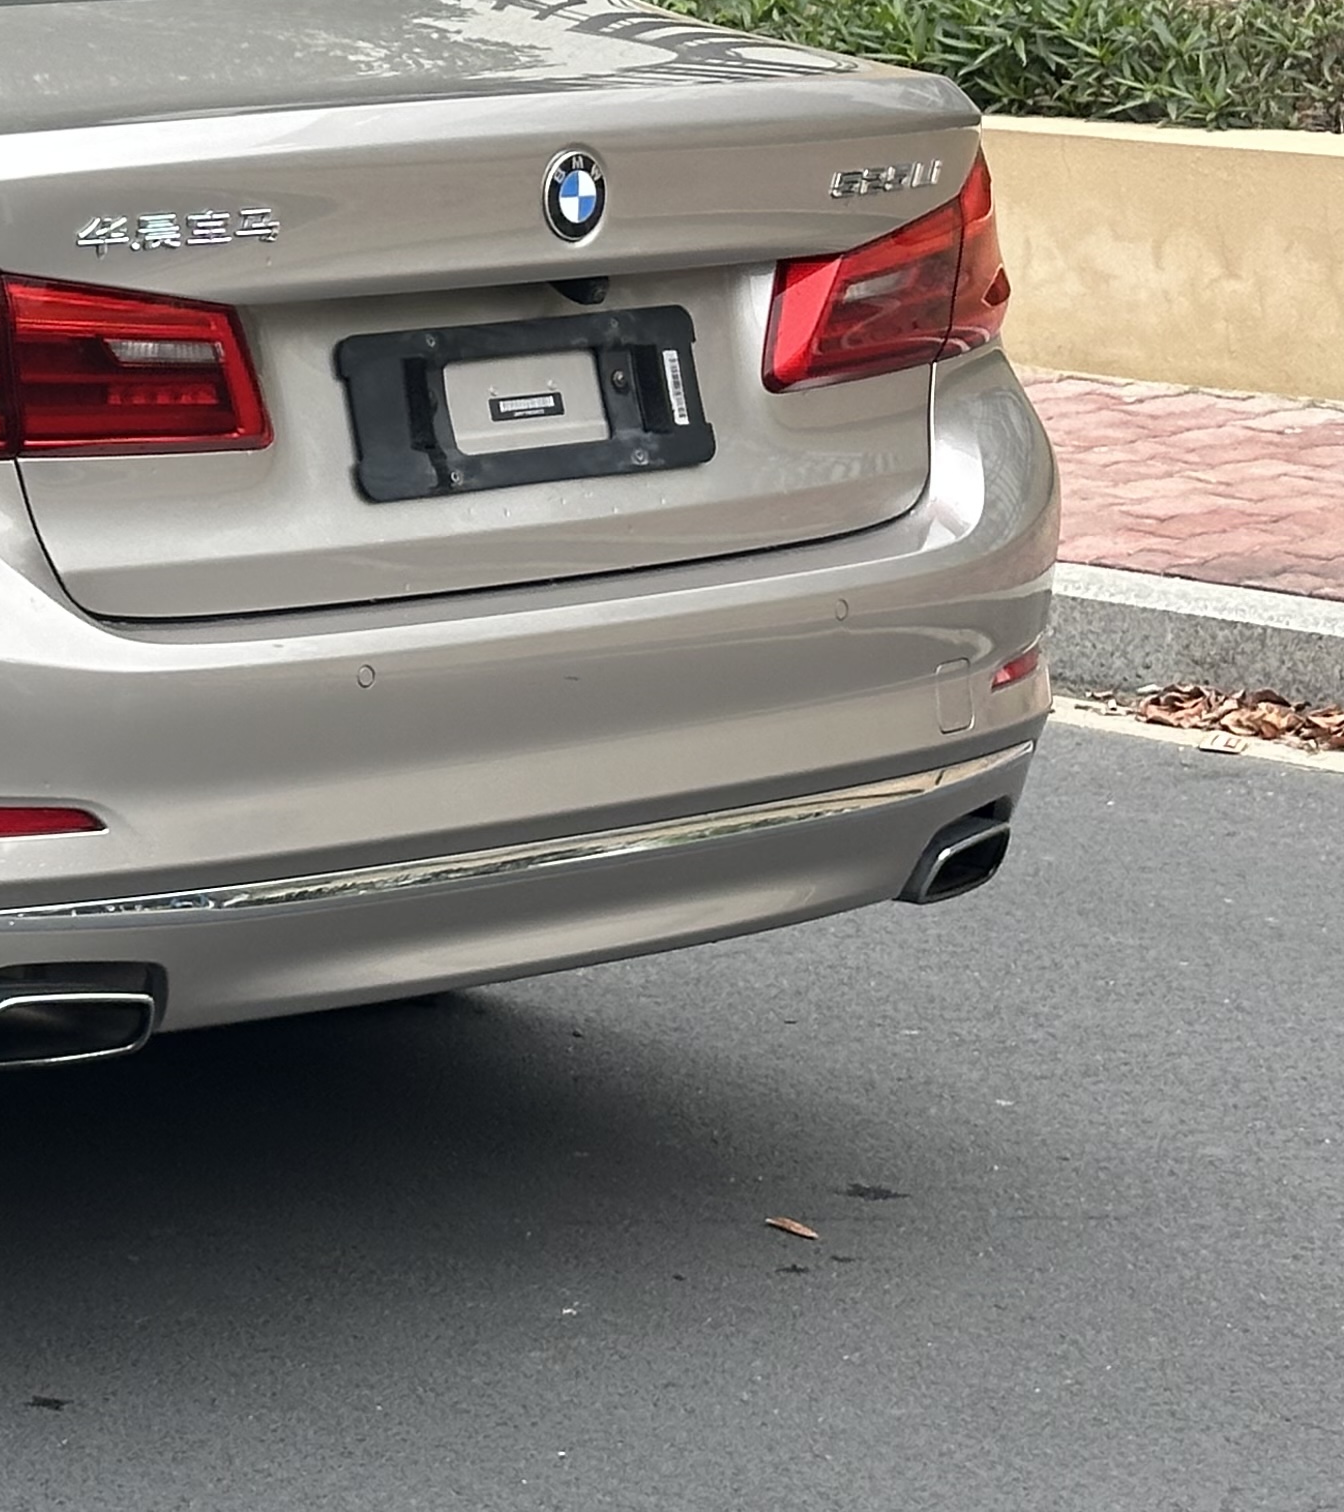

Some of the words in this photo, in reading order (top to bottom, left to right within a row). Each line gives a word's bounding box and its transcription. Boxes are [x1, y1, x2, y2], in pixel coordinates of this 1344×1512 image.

[553, 155, 601, 183] BMW
[76, 207, 280, 259] 华晨宝马
